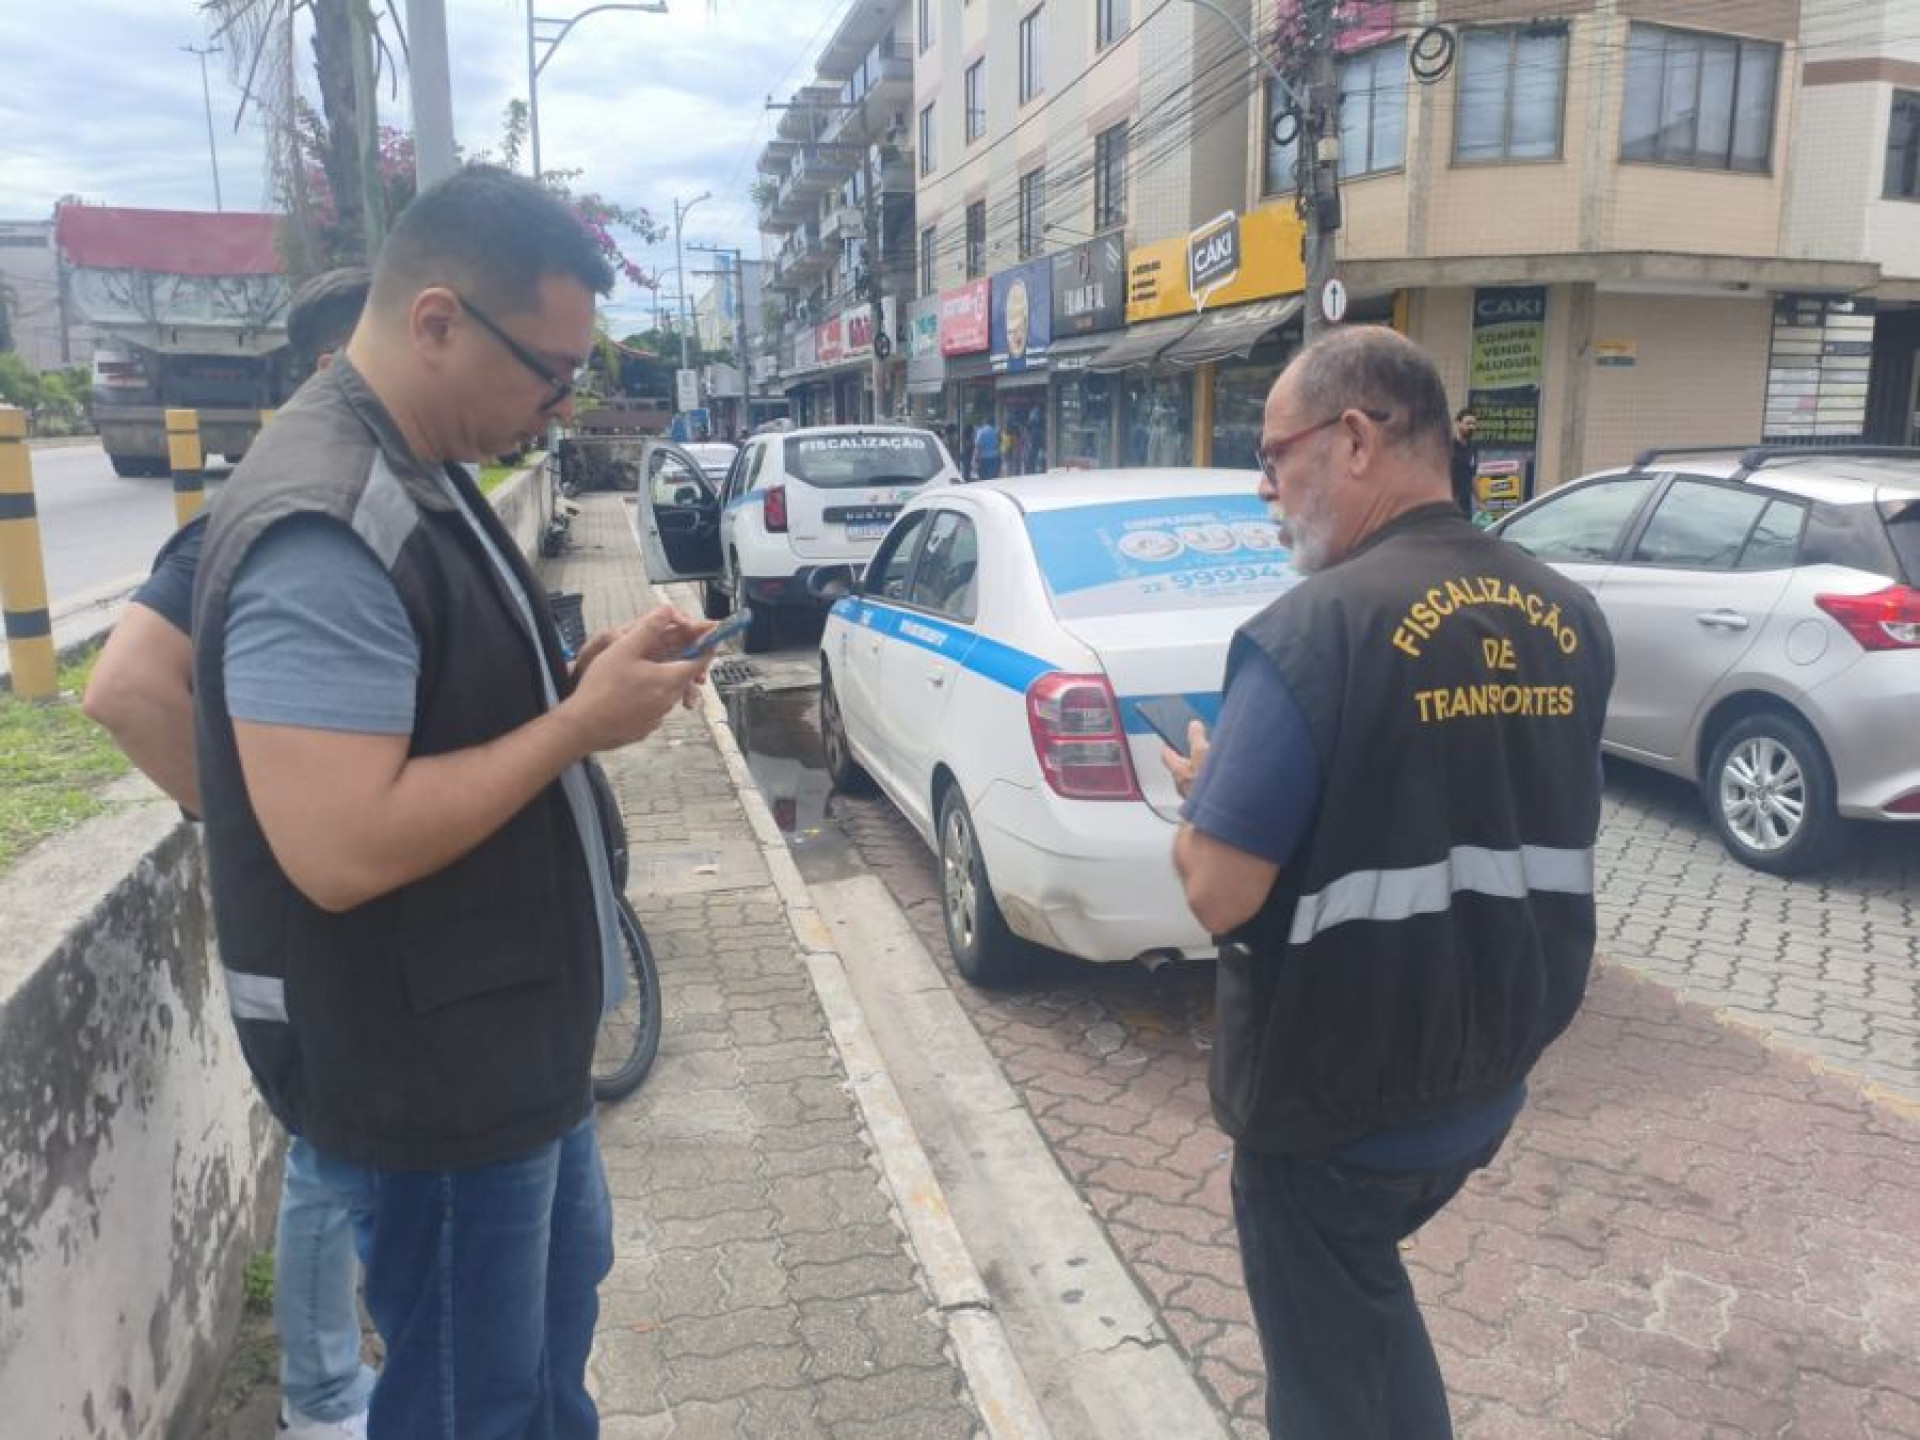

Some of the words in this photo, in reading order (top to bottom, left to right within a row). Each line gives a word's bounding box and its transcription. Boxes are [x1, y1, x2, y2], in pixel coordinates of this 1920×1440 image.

[1194, 231, 1232, 272] CAKI
[1478, 299, 1542, 316] CAKI
[1476, 328, 1537, 344] COMPRA
[1481, 342, 1532, 357] VENDA
[1475, 355, 1542, 373] ALUGUEL
[799, 436, 926, 452] FISCALIZAÇÃO
[1393, 577, 1578, 657] FISCALIZAÇÃO
[1483, 637, 1517, 669] DE
